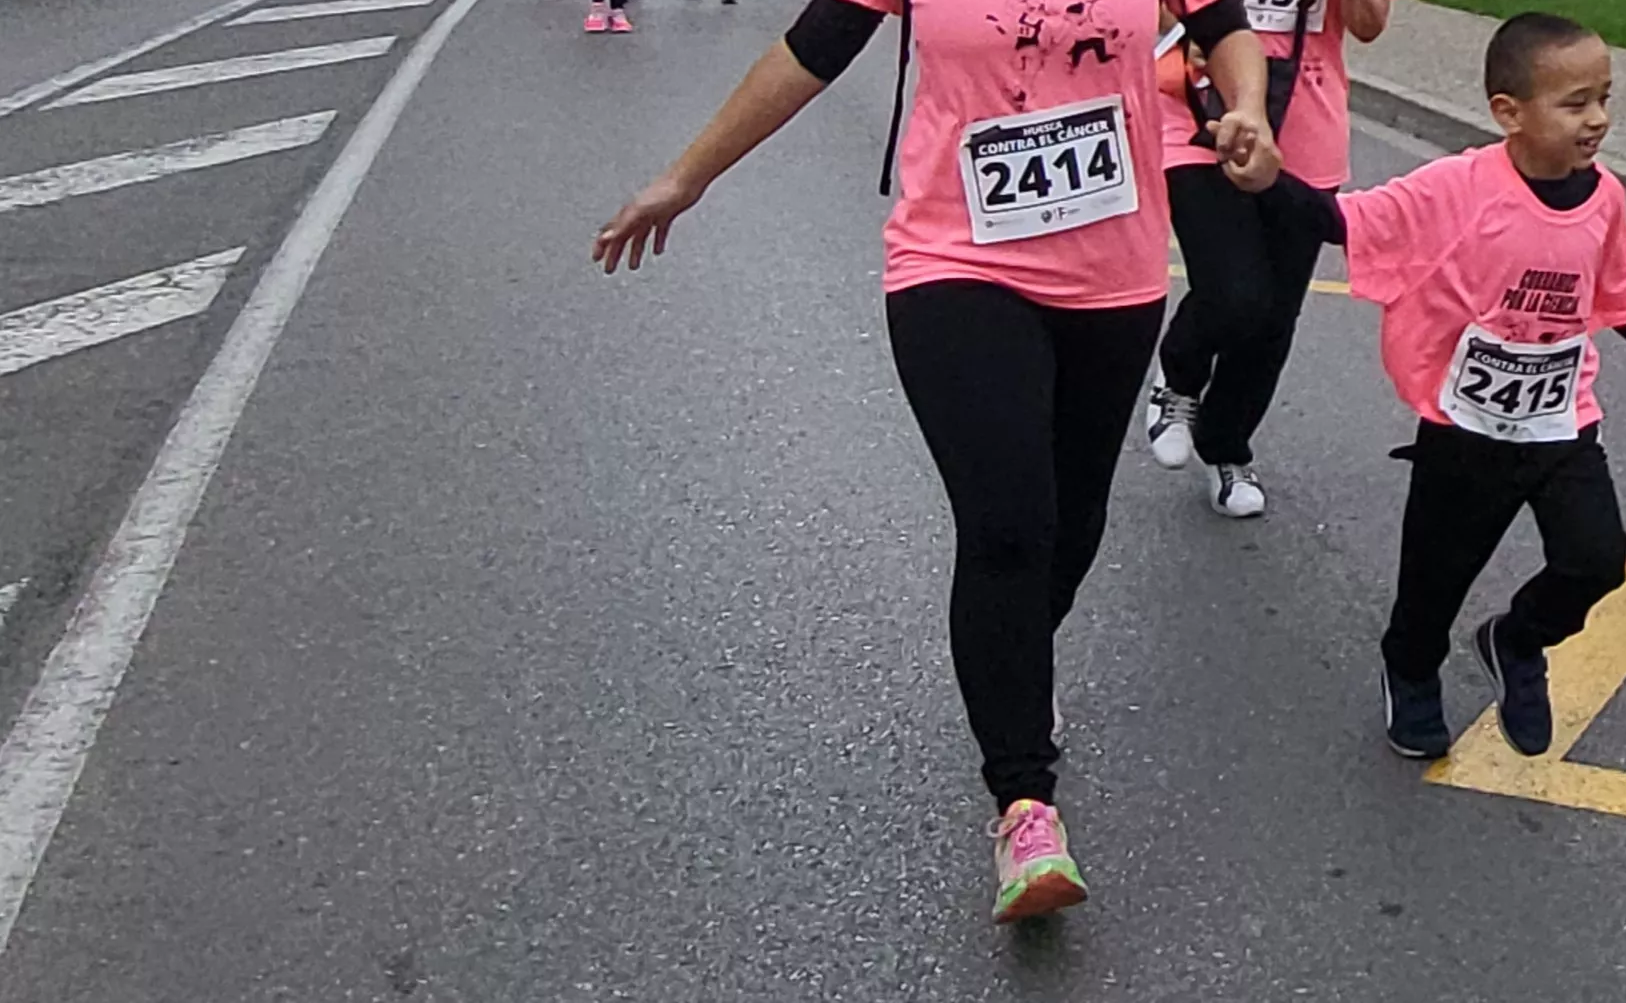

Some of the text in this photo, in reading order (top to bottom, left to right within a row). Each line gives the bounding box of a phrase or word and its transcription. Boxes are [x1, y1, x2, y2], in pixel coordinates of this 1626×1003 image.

[1023, 120, 1063, 136] HUESCA
[978, 136, 1036, 156] CONTRA
[1040, 135, 1057, 147] EL
[980, 138, 1118, 207] 2414
[1474, 350, 1523, 374] CONTRA
[1526, 363, 1538, 374] EL
[1460, 366, 1570, 414] 2415
